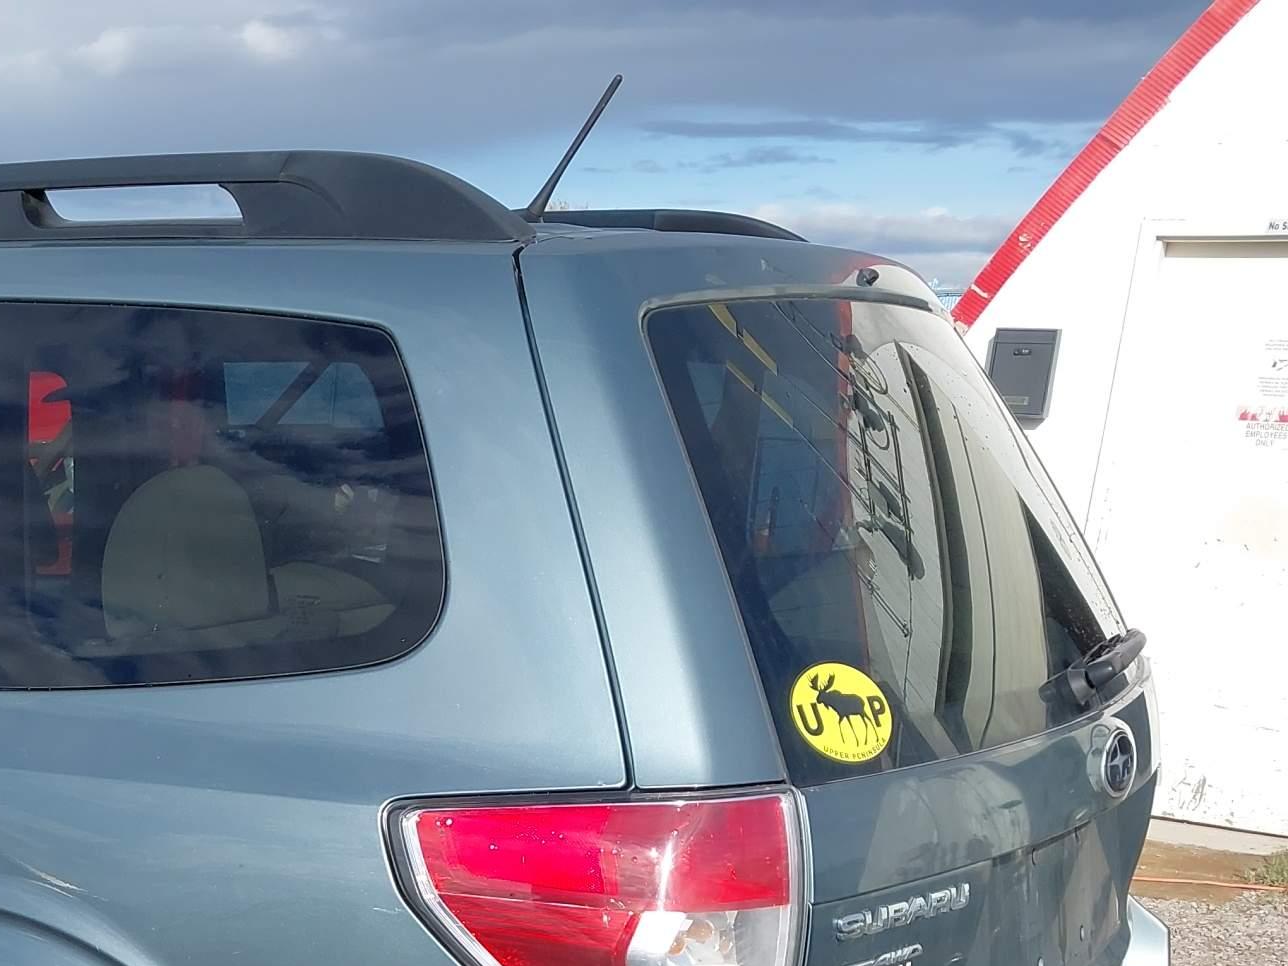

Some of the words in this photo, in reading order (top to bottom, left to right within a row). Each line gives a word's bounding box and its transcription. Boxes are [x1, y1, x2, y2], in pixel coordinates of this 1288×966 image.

[1268, 221, 1280, 231] No
[1245, 430, 1288, 440] EMPLOYEES
[1255, 438, 1275, 448] ONLY
[796, 702, 825, 736] U
[865, 695, 886, 728] P
[823, 745, 849, 759] UPPER
[852, 737, 887, 760] PENINSULA
[832, 882, 970, 942] SUBARU
